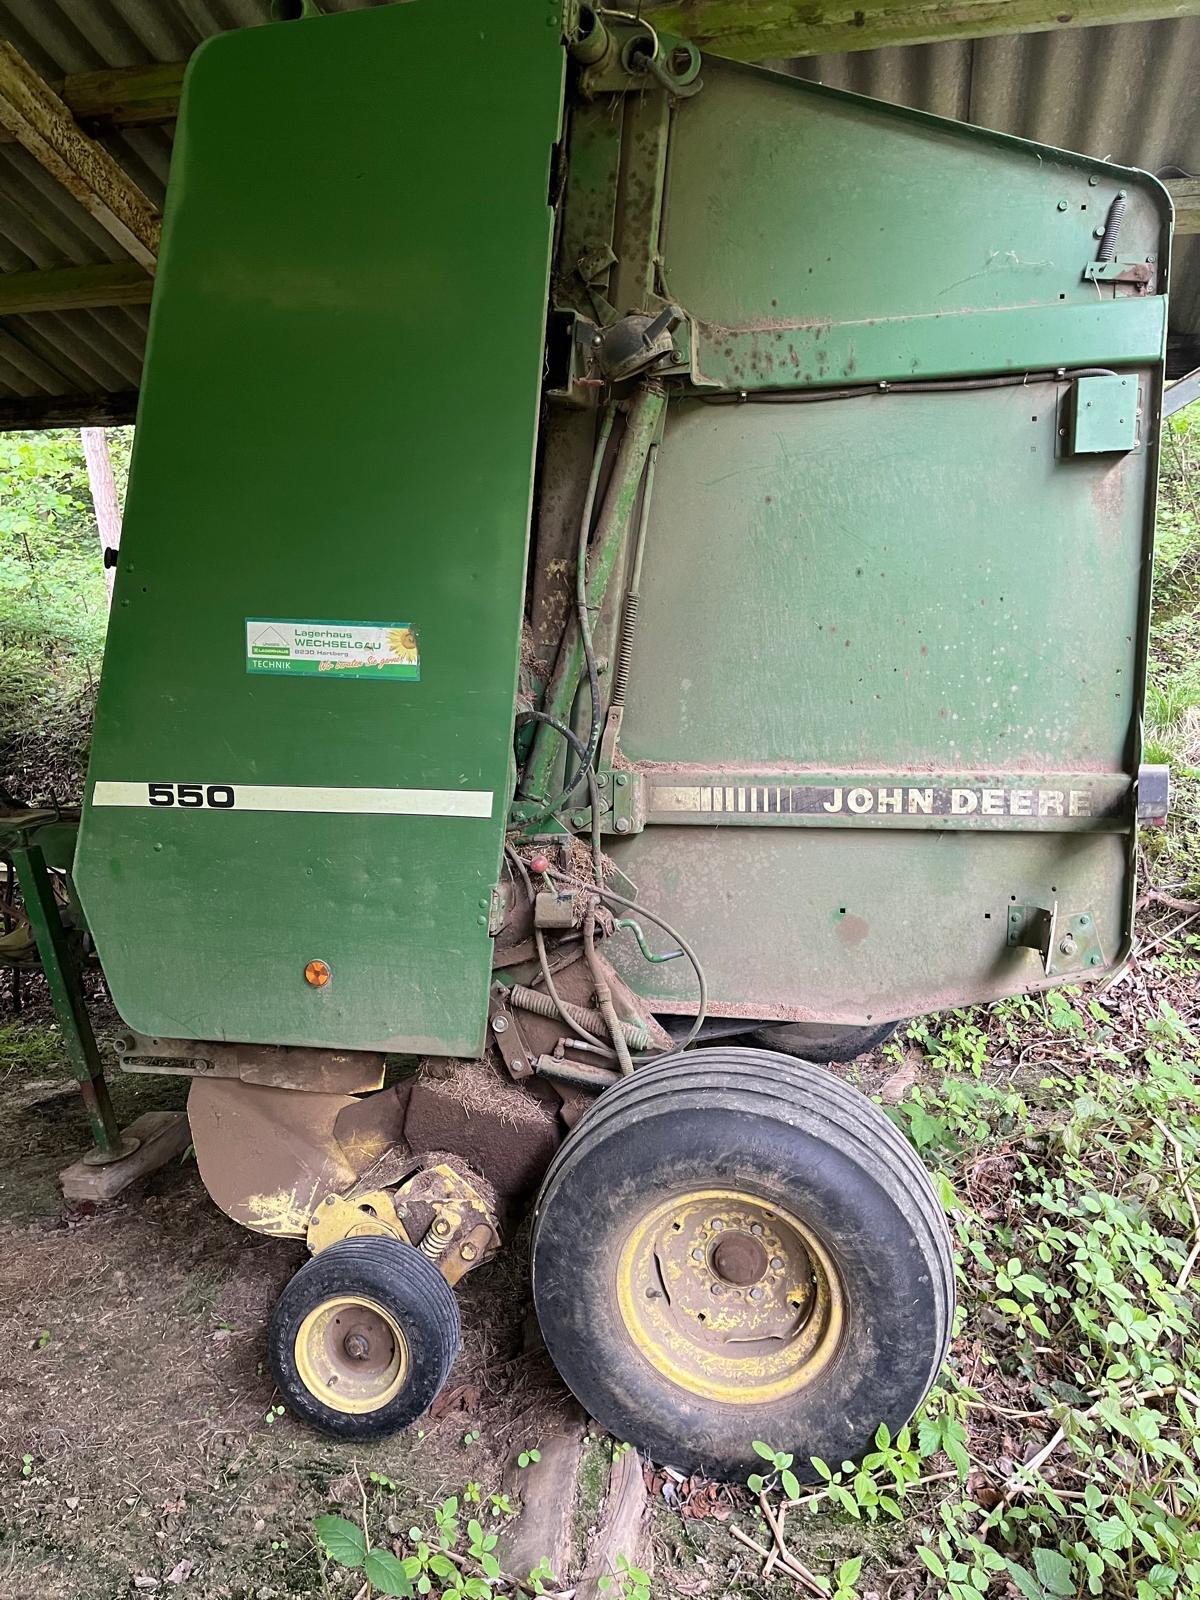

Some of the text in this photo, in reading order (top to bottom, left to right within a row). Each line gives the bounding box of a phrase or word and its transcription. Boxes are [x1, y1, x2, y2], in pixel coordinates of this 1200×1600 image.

[294, 629, 352, 639] Lagerhaus
[294, 639, 381, 650] WECHSELGAU
[252, 660, 291, 669] TECHNIK
[148, 783, 235, 809] 550
[823, 787, 1091, 817] JOHN DEERE
